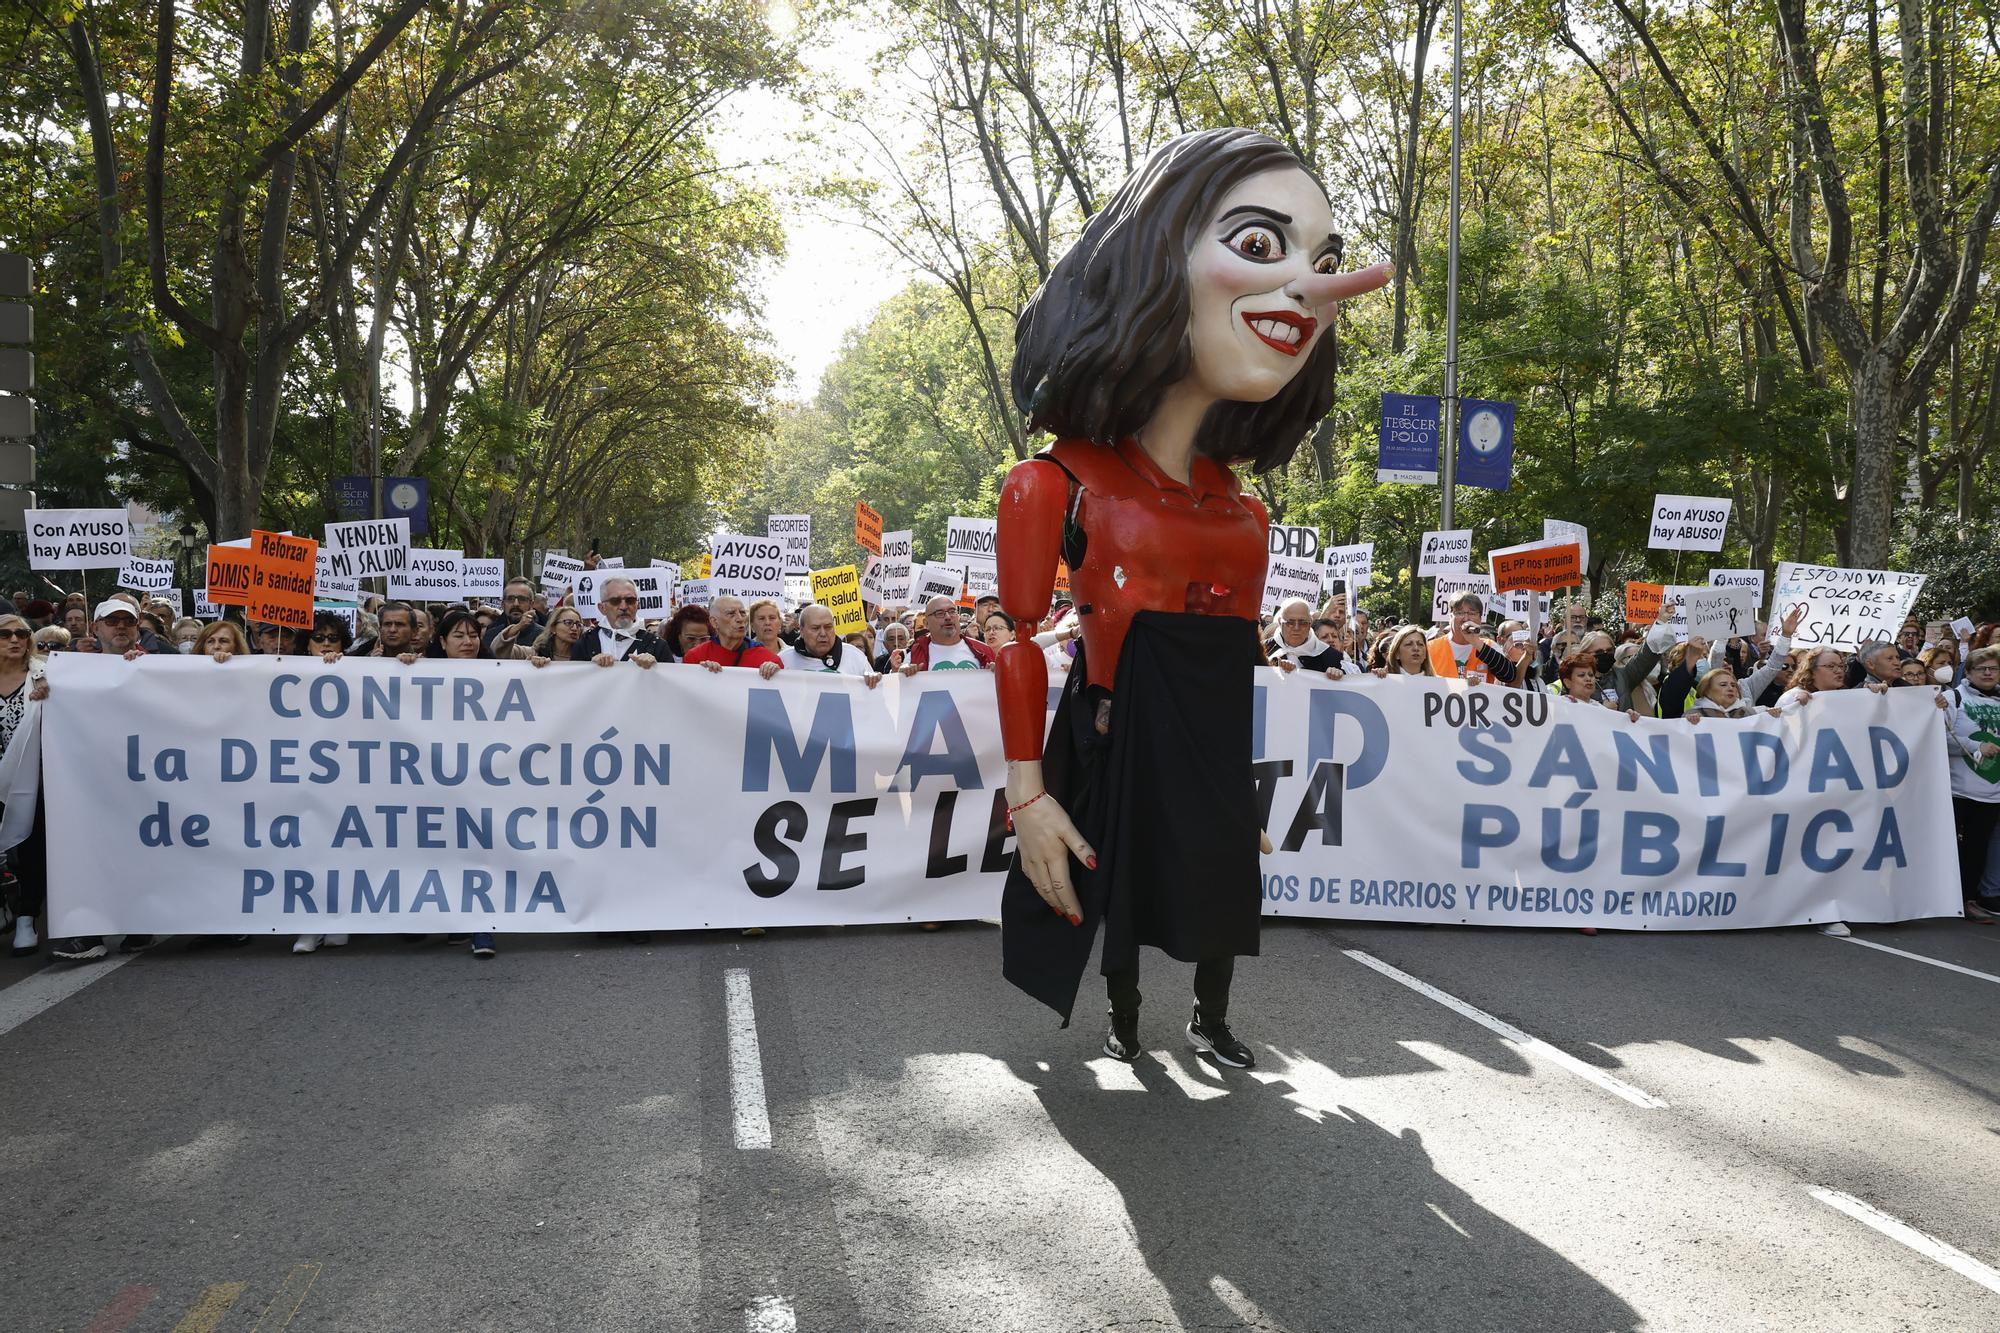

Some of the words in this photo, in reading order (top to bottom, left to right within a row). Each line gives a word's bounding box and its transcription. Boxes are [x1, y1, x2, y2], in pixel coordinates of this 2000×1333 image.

[1403, 405, 1417, 416] EL
[1657, 507, 1681, 521] Con
[1684, 510, 1725, 523] AYUSO
[33, 523, 66, 538] Con
[69, 522, 125, 537] AYUSO
[770, 519, 808, 533] RECORTES
[1653, 525, 1676, 541] hay
[1677, 527, 1723, 541] ABUSO!
[334, 523, 399, 549] VENDEN
[34, 543, 62, 560] hay
[65, 541, 128, 557] ABUSO!
[260, 535, 309, 564] Reforzar
[715, 541, 784, 563] ¡AYUSO,
[883, 540, 911, 558] AYUSO:
[359, 544, 407, 576] SALUD!
[411, 559, 458, 578] AYUSO,
[1424, 554, 1438, 565] MIL
[1514, 558, 1524, 571] PP
[1528, 558, 1541, 569] nos
[122, 573, 172, 588] SALUD!
[253, 564, 263, 586] la
[267, 570, 312, 596] sanidad
[543, 571, 563, 581] SALUD
[714, 563, 782, 581] ABUSO!
[1326, 569, 1339, 579] MIL
[1508, 572, 1541, 588] Atención
[1790, 568, 1838, 583] ESTO
[1867, 572, 1885, 586] VA
[391, 574, 412, 589] MIL
[414, 572, 460, 592] abusos.
[470, 578, 502, 590] abusos.
[812, 571, 855, 596] ¡Recortan
[577, 595, 595, 606] MIL
[831, 589, 858, 606] salud
[1266, 586, 1282, 601] muy
[1809, 586, 1896, 604] COLORES
[261, 603, 311, 626] cercana.
[842, 606, 863, 623] vida!
[1831, 603, 1850, 617] VA
[1798, 621, 1892, 645] SALUD
[269, 674, 536, 721] CONTRA
[1424, 691, 1495, 729] POR
[1502, 692, 1549, 728] SU
[127, 734, 188, 783] la
[220, 725, 672, 787] DESTRUCCIÓN
[1456, 723, 1910, 798] SANIDAD
[139, 801, 210, 848] de
[243, 801, 301, 848] la
[331, 788, 658, 850] ATENCIÓN
[1460, 791, 1908, 877] PÚBLICA
[742, 797, 878, 899] SE
[241, 868, 566, 914] PRIMARIA
[1309, 877, 1341, 905] DE
[1350, 878, 1457, 910] BARRIOS
[1466, 884, 1482, 911] Y
[1488, 885, 1595, 916] PUEBLOS
[1603, 889, 1635, 916] DE
[1641, 890, 1737, 917] MADRID
